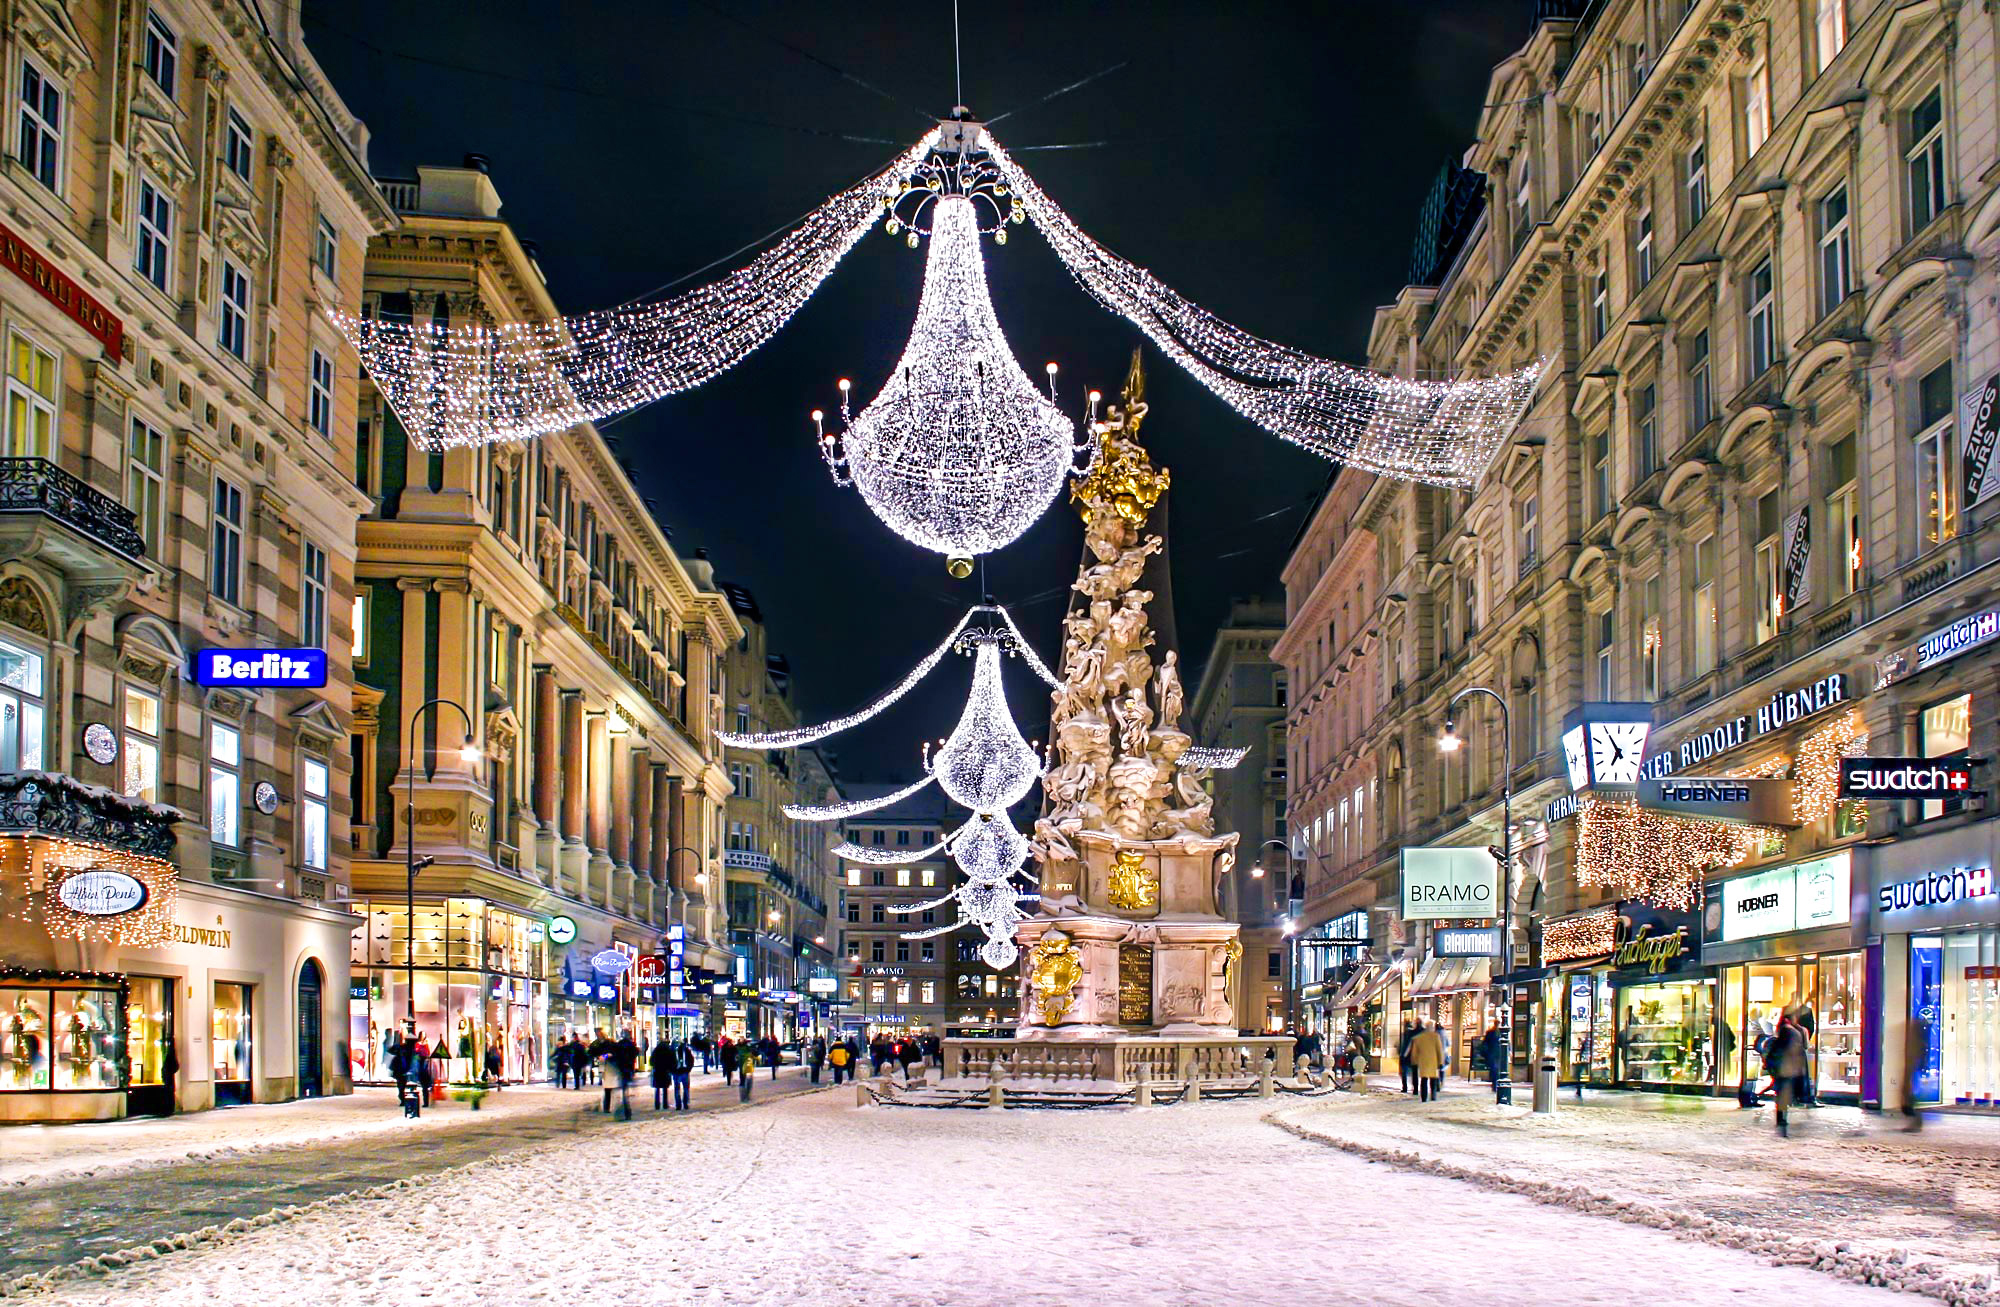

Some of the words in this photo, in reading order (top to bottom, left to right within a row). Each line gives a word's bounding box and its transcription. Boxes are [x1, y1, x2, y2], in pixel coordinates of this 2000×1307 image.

[79, 295, 116, 338] HOF
[1967, 386, 1997, 461] ZIKOS
[1968, 429, 1996, 494] FURS
[1788, 514, 1808, 573] ZIKOS
[1788, 539, 1810, 600] PELZE
[1918, 614, 1980, 664] swatch
[212, 653, 310, 679] Berlitz
[1680, 716, 1748, 767] RUDOLF
[1757, 673, 1842, 734] HÜBNER
[1849, 766, 1949, 790] swatch
[102, 885, 137, 900] Denk
[1411, 884, 1490, 901] BRAMO
[1879, 867, 1967, 912] swatch
